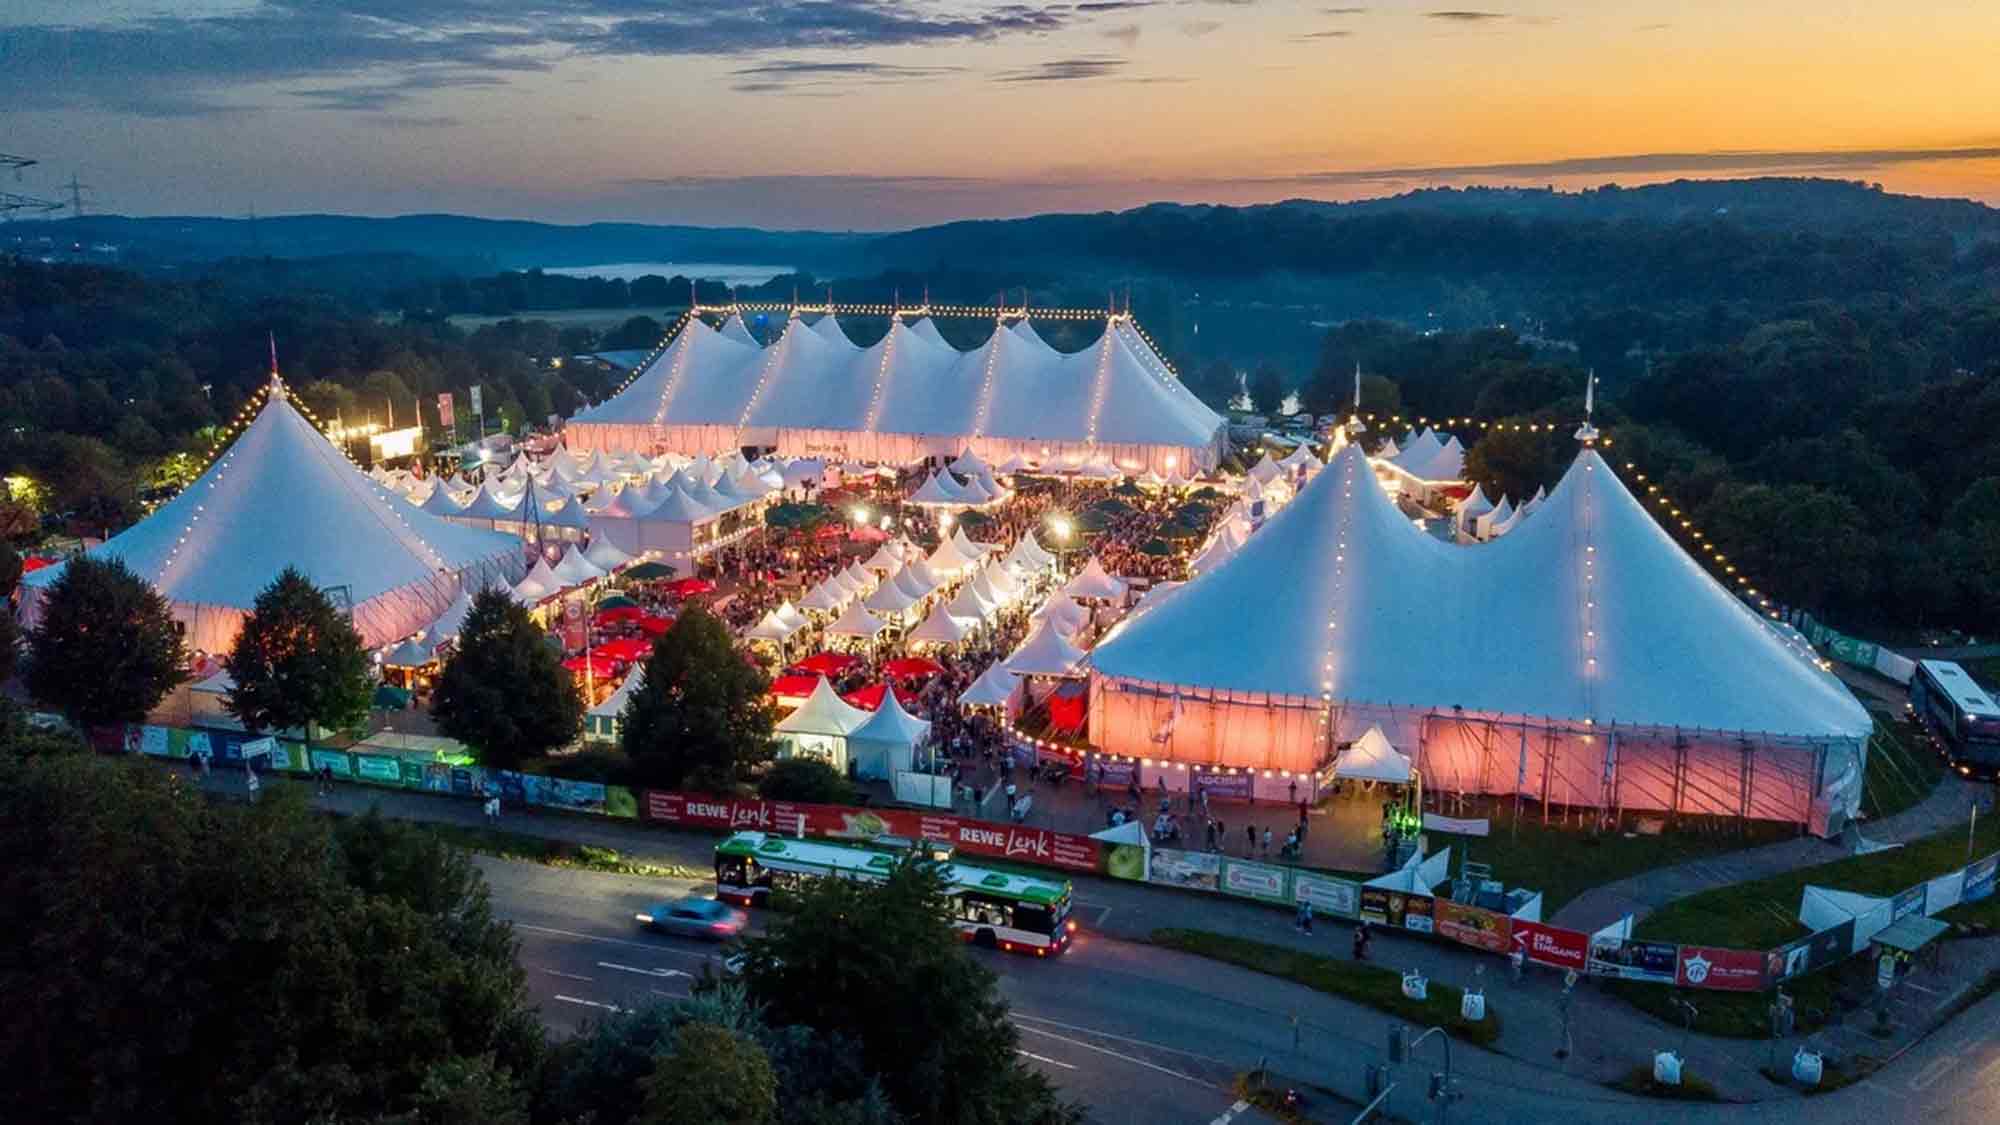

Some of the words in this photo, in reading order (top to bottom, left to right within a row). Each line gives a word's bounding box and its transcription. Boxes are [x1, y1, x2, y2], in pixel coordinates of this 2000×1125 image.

[686, 802, 729, 819] REWE
[730, 802, 772, 827] Lenk
[959, 827, 1005, 847] REWE
[1005, 829, 1049, 857] Lenk
